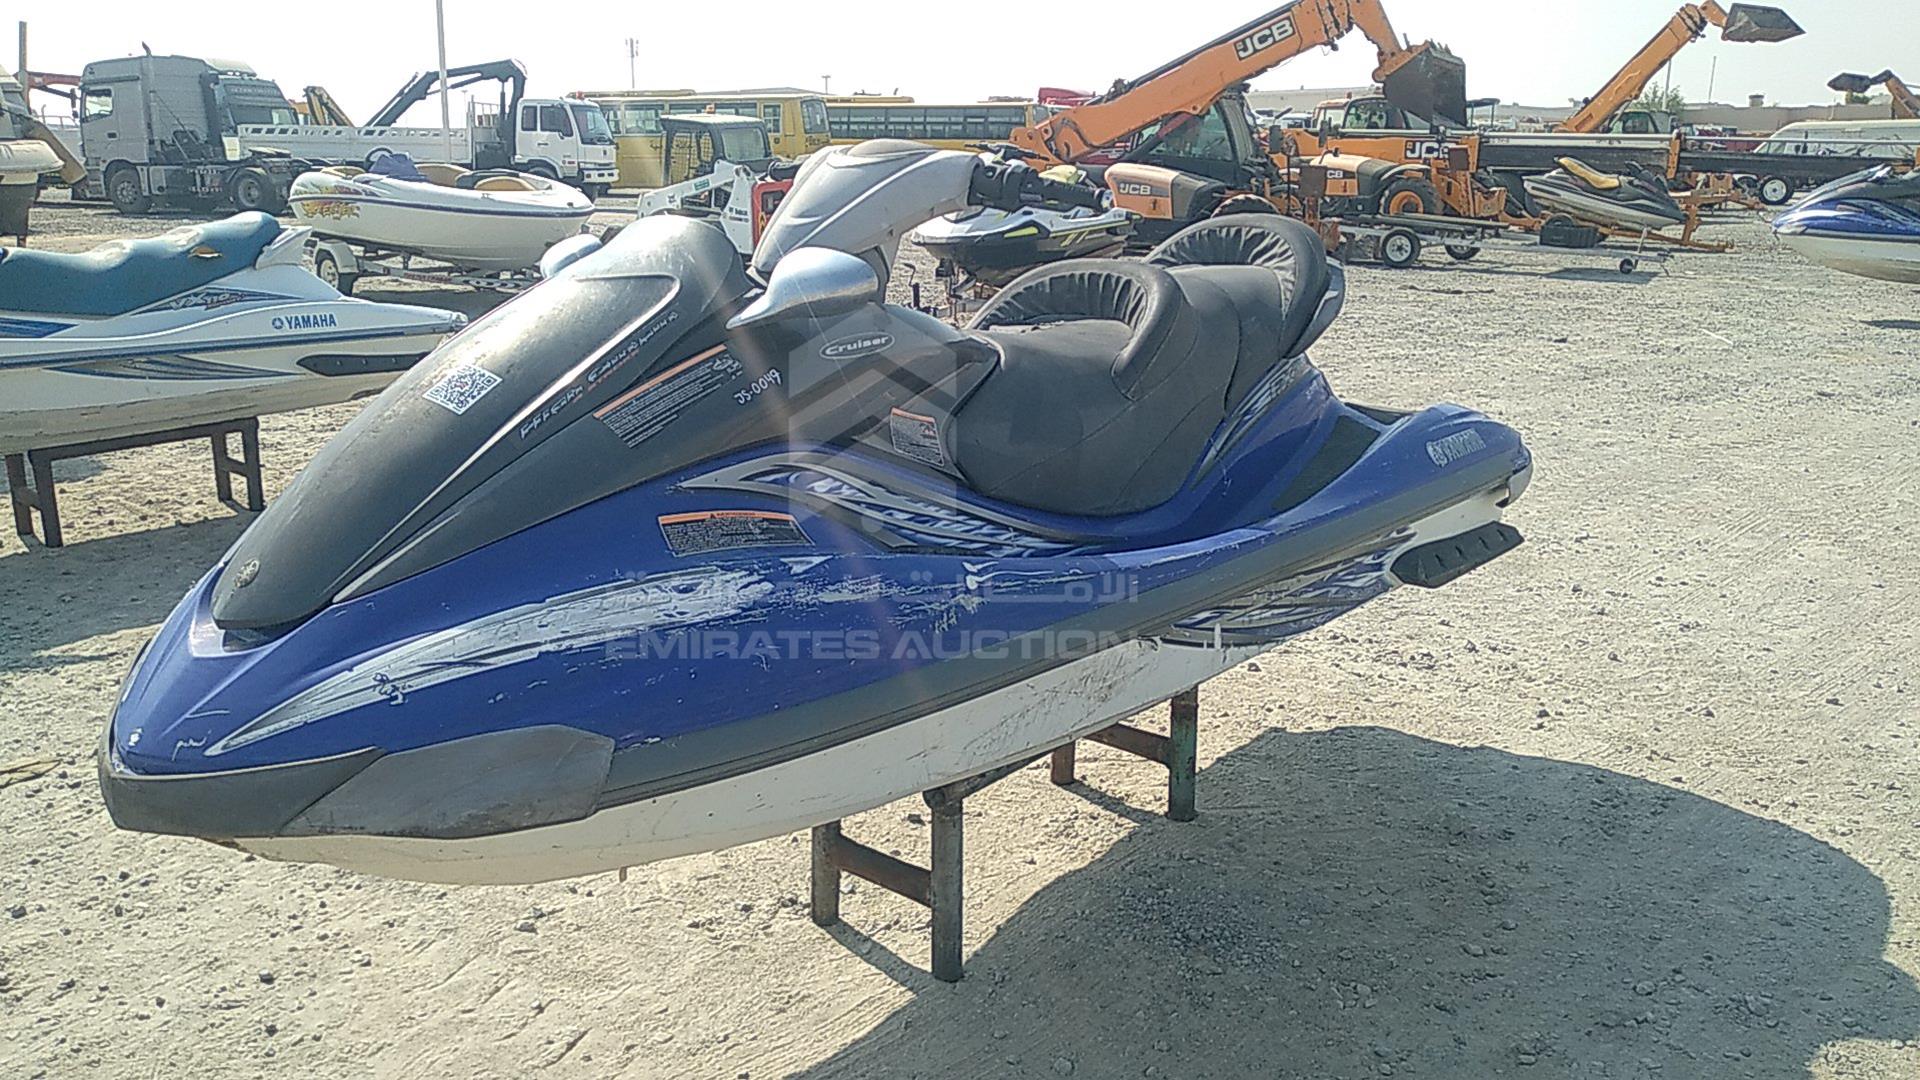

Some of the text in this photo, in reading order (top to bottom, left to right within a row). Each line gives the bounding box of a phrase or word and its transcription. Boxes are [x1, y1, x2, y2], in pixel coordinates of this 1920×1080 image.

[1235, 19, 1294, 58] JCB
[1327, 170, 1343, 178] CB
[1119, 183, 1151, 195] JCB
[285, 314, 337, 330] YAMAHA
[824, 333, 889, 355] Cruiser
